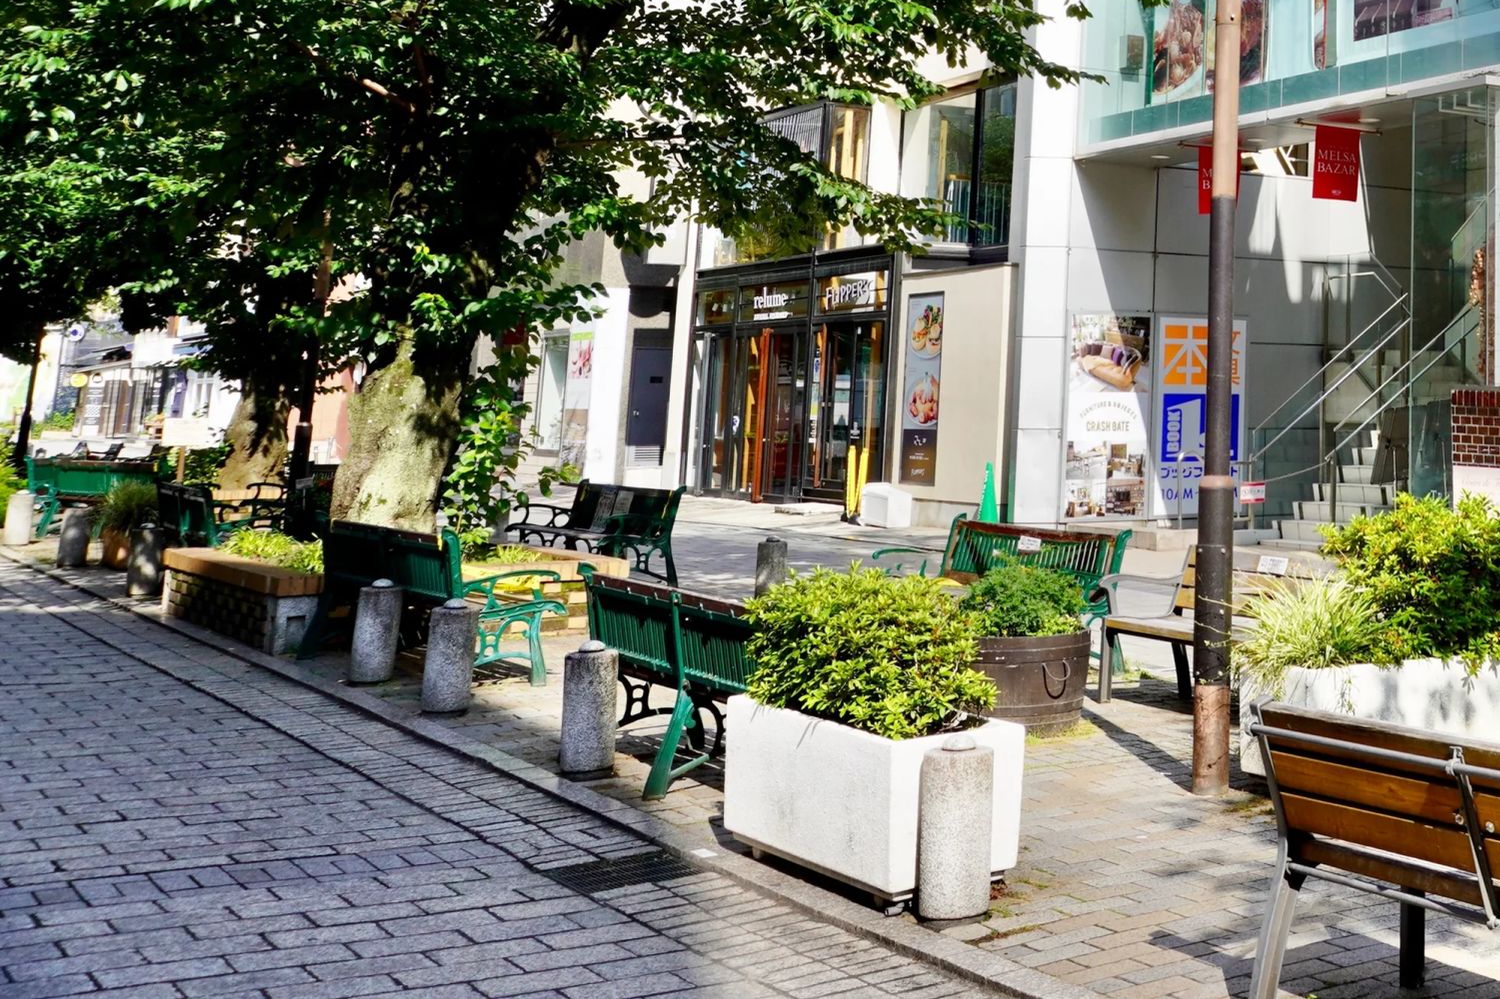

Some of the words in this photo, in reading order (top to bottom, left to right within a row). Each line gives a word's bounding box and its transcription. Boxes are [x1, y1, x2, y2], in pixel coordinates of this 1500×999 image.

[1317, 148, 1357, 164] MELSA
[1317, 161, 1356, 177] BAZAR
[753, 286, 789, 309] relume
[1086, 420, 1110, 432] CRASH
[1166, 408, 1181, 453] BOOK
